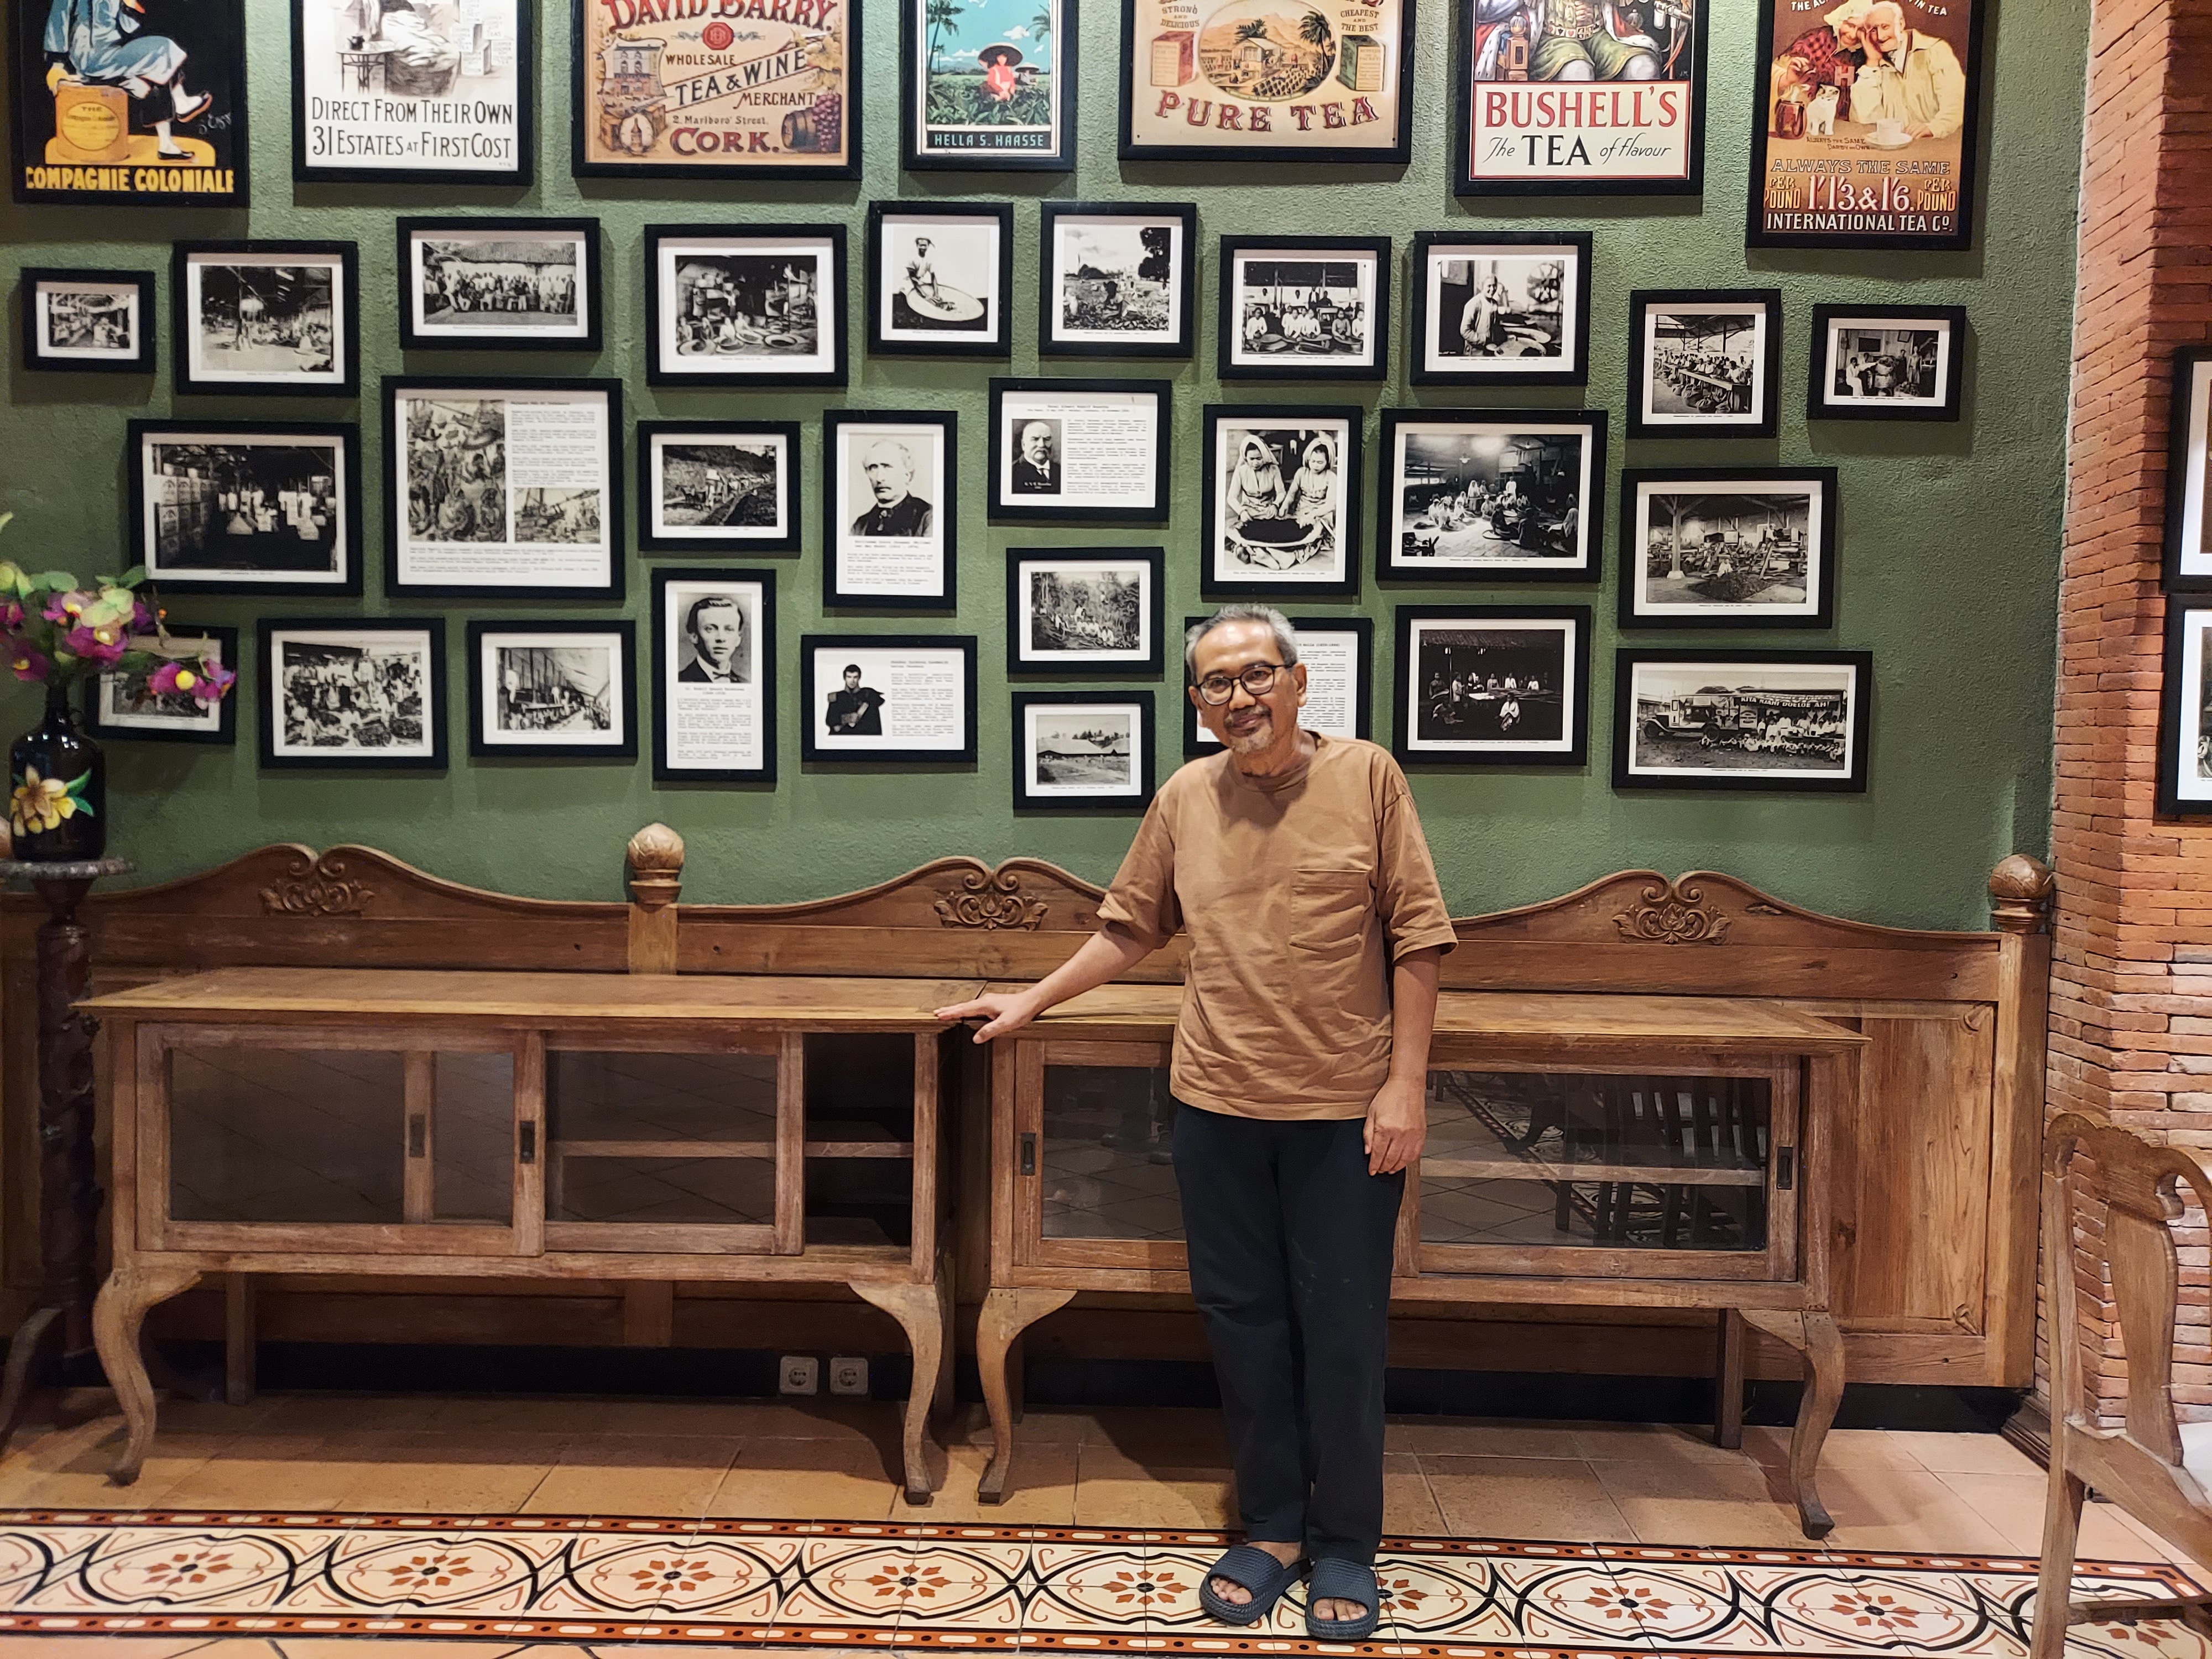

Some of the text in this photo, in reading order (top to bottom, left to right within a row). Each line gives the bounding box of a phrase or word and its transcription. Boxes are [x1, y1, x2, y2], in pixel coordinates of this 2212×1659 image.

[1340, 9, 1379, 19] CHEAPEST
[1791, 1, 1812, 11] THE
[1928, 5, 1947, 15] TEA
[602, 0, 708, 33] DAVID
[1160, 19, 1199, 28] DELICIOUS
[1341, 23, 1378, 32] THE BEST
[666, 55, 735, 65] WHOLESALE
[675, 49, 807, 106] TEA & WINE
[733, 93, 816, 109] MERCHANT
[1485, 86, 1677, 128] BUSHELL'S
[312, 97, 512, 124] DIRECT FROM THEIR OWN
[1155, 90, 1379, 132] PURE TEA
[312, 126, 512, 158] 31 ESTATES AT FIRST COST
[670, 127, 780, 155] CORK.
[935, 134, 1044, 147] HELLA S. HAASSE
[1482, 137, 1515, 164] The
[1521, 134, 1592, 165] TEA
[1599, 137, 1622, 165] of
[1771, 159, 1950, 175] ALWAYS THE SAME
[26, 167, 234, 192] COMPAGNIE COLONIALE
[1770, 175, 1795, 189] PER
[1924, 177, 1951, 191] PER
[1764, 189, 1801, 209] POUND
[1917, 190, 1957, 212] POUND
[1767, 213, 1895, 231] INTERNATIONAL
[1899, 215, 1927, 231] TEA
